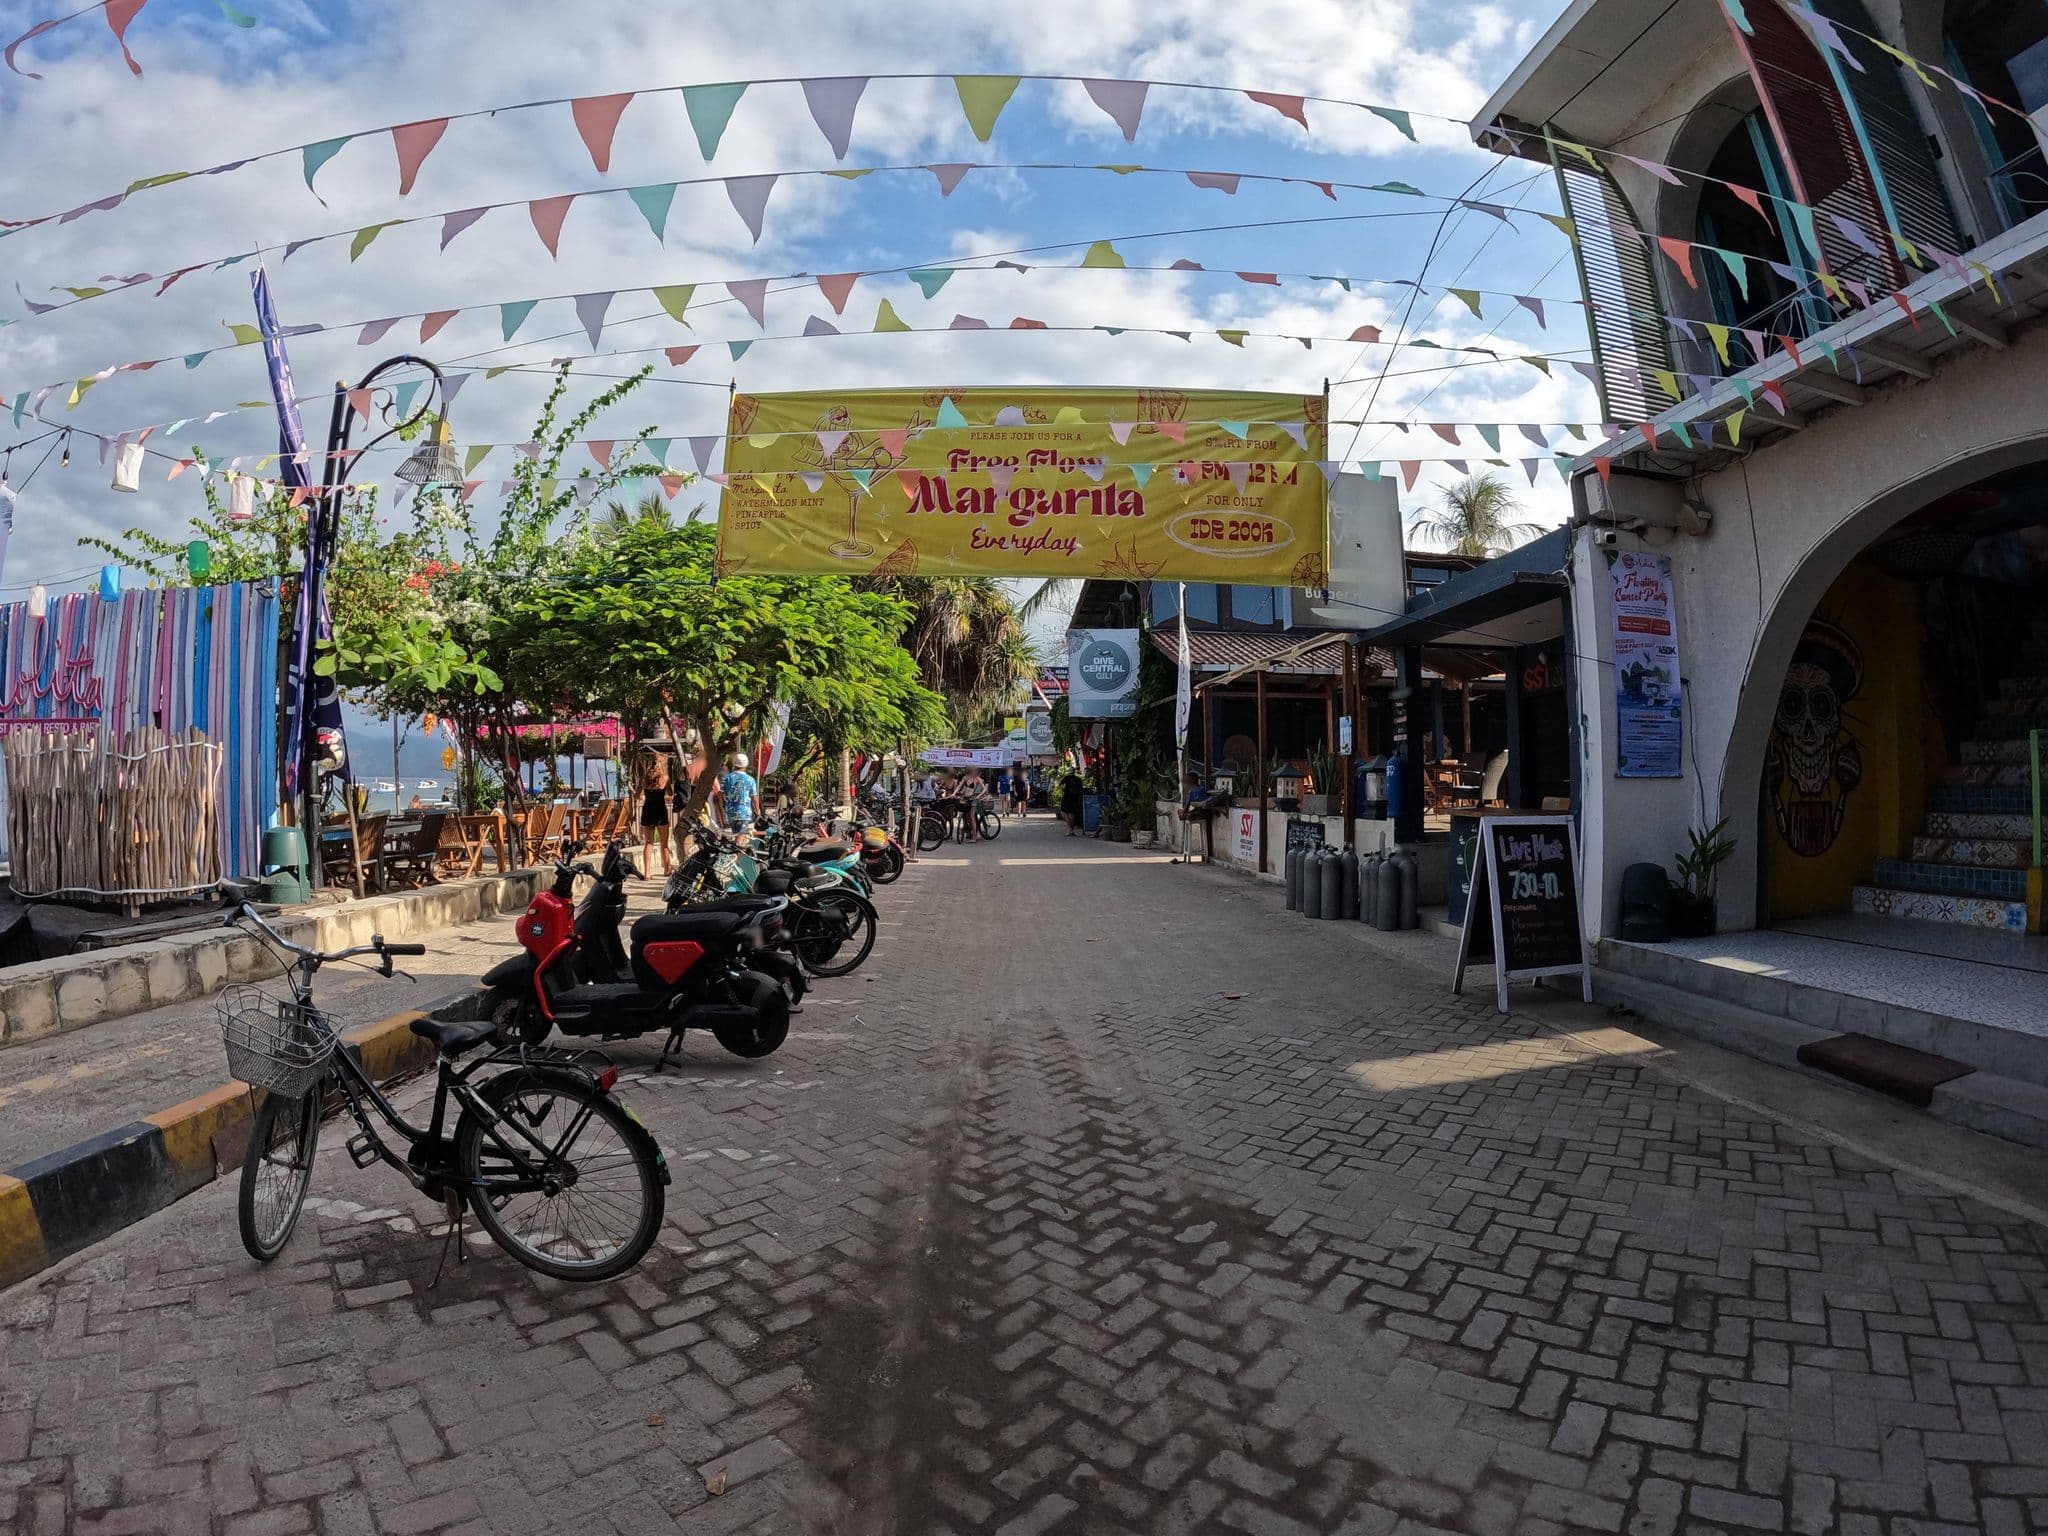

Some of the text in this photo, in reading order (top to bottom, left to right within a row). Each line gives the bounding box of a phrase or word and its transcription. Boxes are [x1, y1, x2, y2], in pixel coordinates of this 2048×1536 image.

[971, 432, 1082, 441] PLEASE JOIN US FOR A
[1246, 439, 1278, 450] FROM
[947, 448, 1020, 473] Free
[737, 497, 825, 508] WATERMELON MINT
[907, 476, 1145, 527] Margarita
[1206, 495, 1265, 508] FOR ONLY
[735, 510, 787, 519] PINEAPPLE
[734, 521, 762, 530] SPICY
[1189, 518, 1224, 540] IDR
[970, 527, 1078, 557] Everyday
[1093, 656, 1115, 665] DIVE
[1082, 664, 1126, 673] CENTRAL
[1095, 672, 1113, 680] GILI
